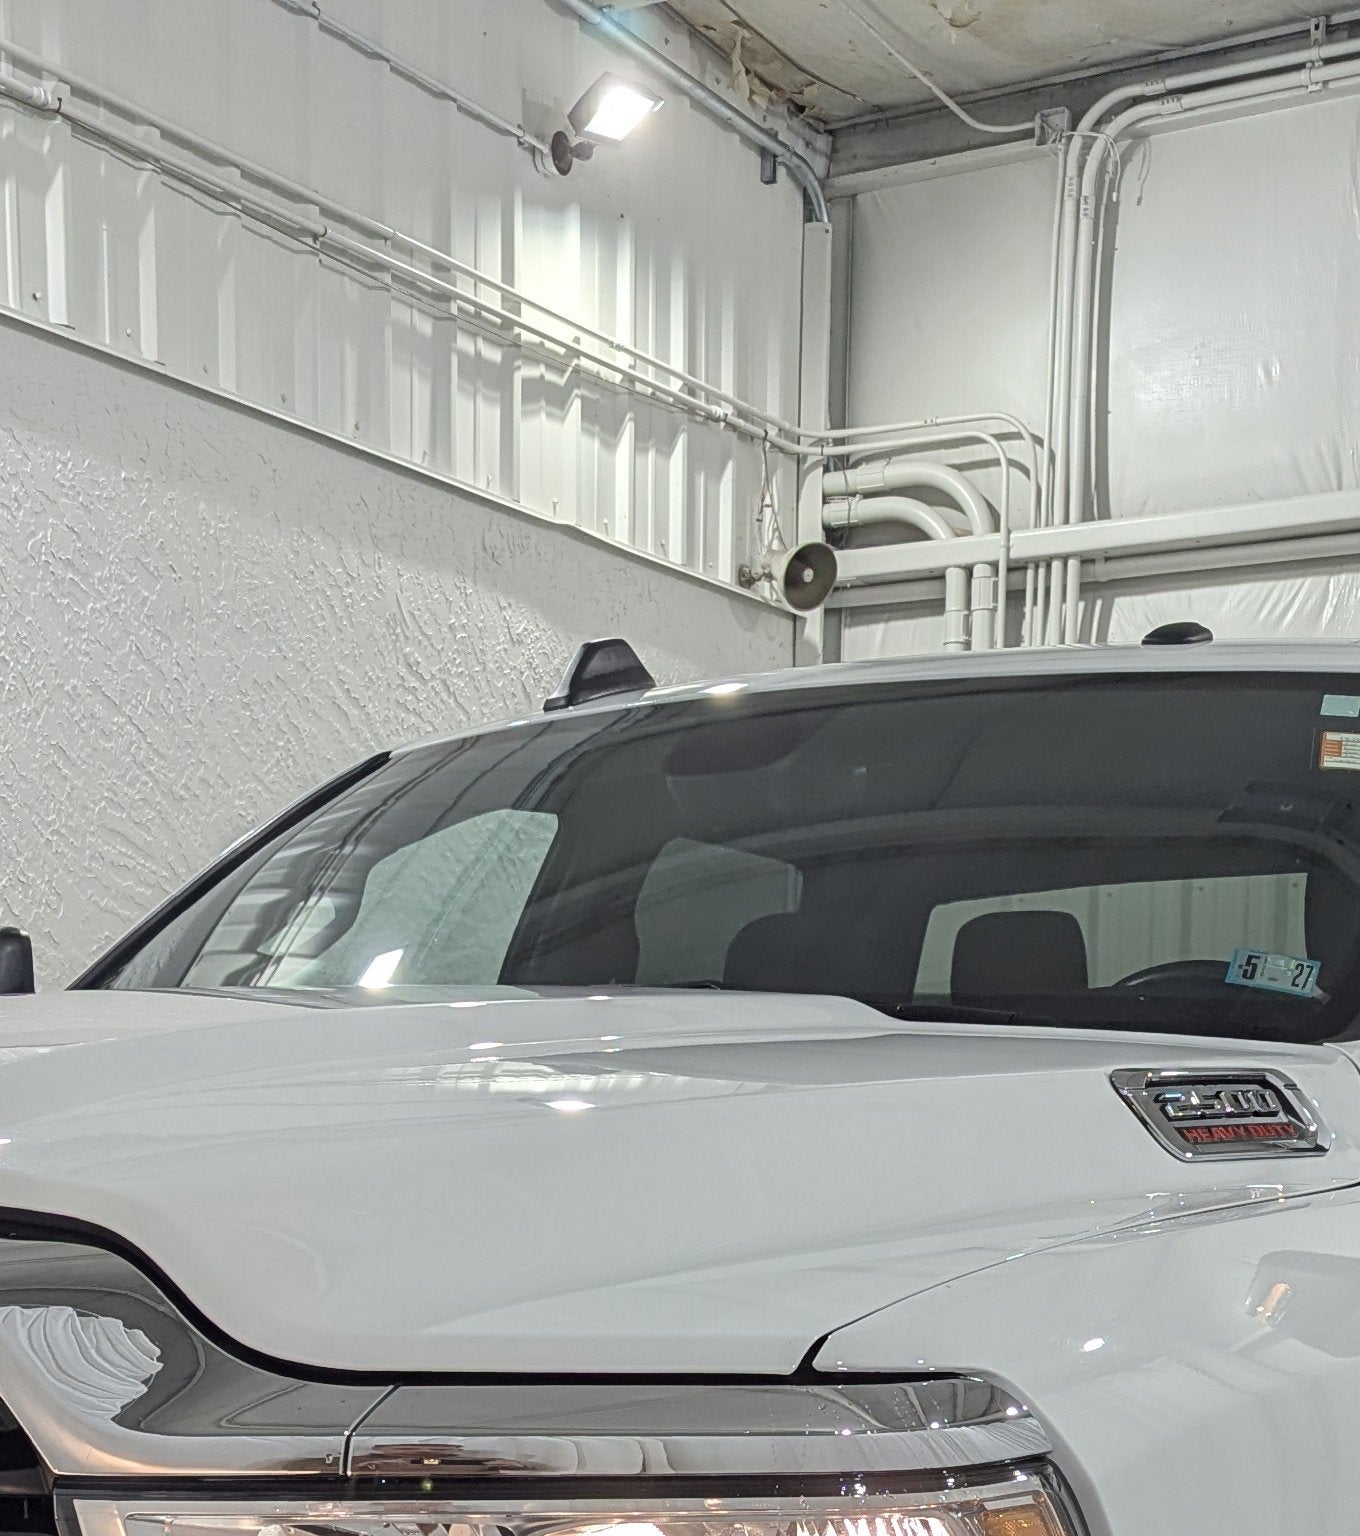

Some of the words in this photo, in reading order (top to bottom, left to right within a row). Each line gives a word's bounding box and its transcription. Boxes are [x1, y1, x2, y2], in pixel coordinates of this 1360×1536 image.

[1290, 962, 1315, 991] 27
[1182, 1126, 1246, 1143] HEAVY
[1247, 1122, 1298, 1140] DUTY
